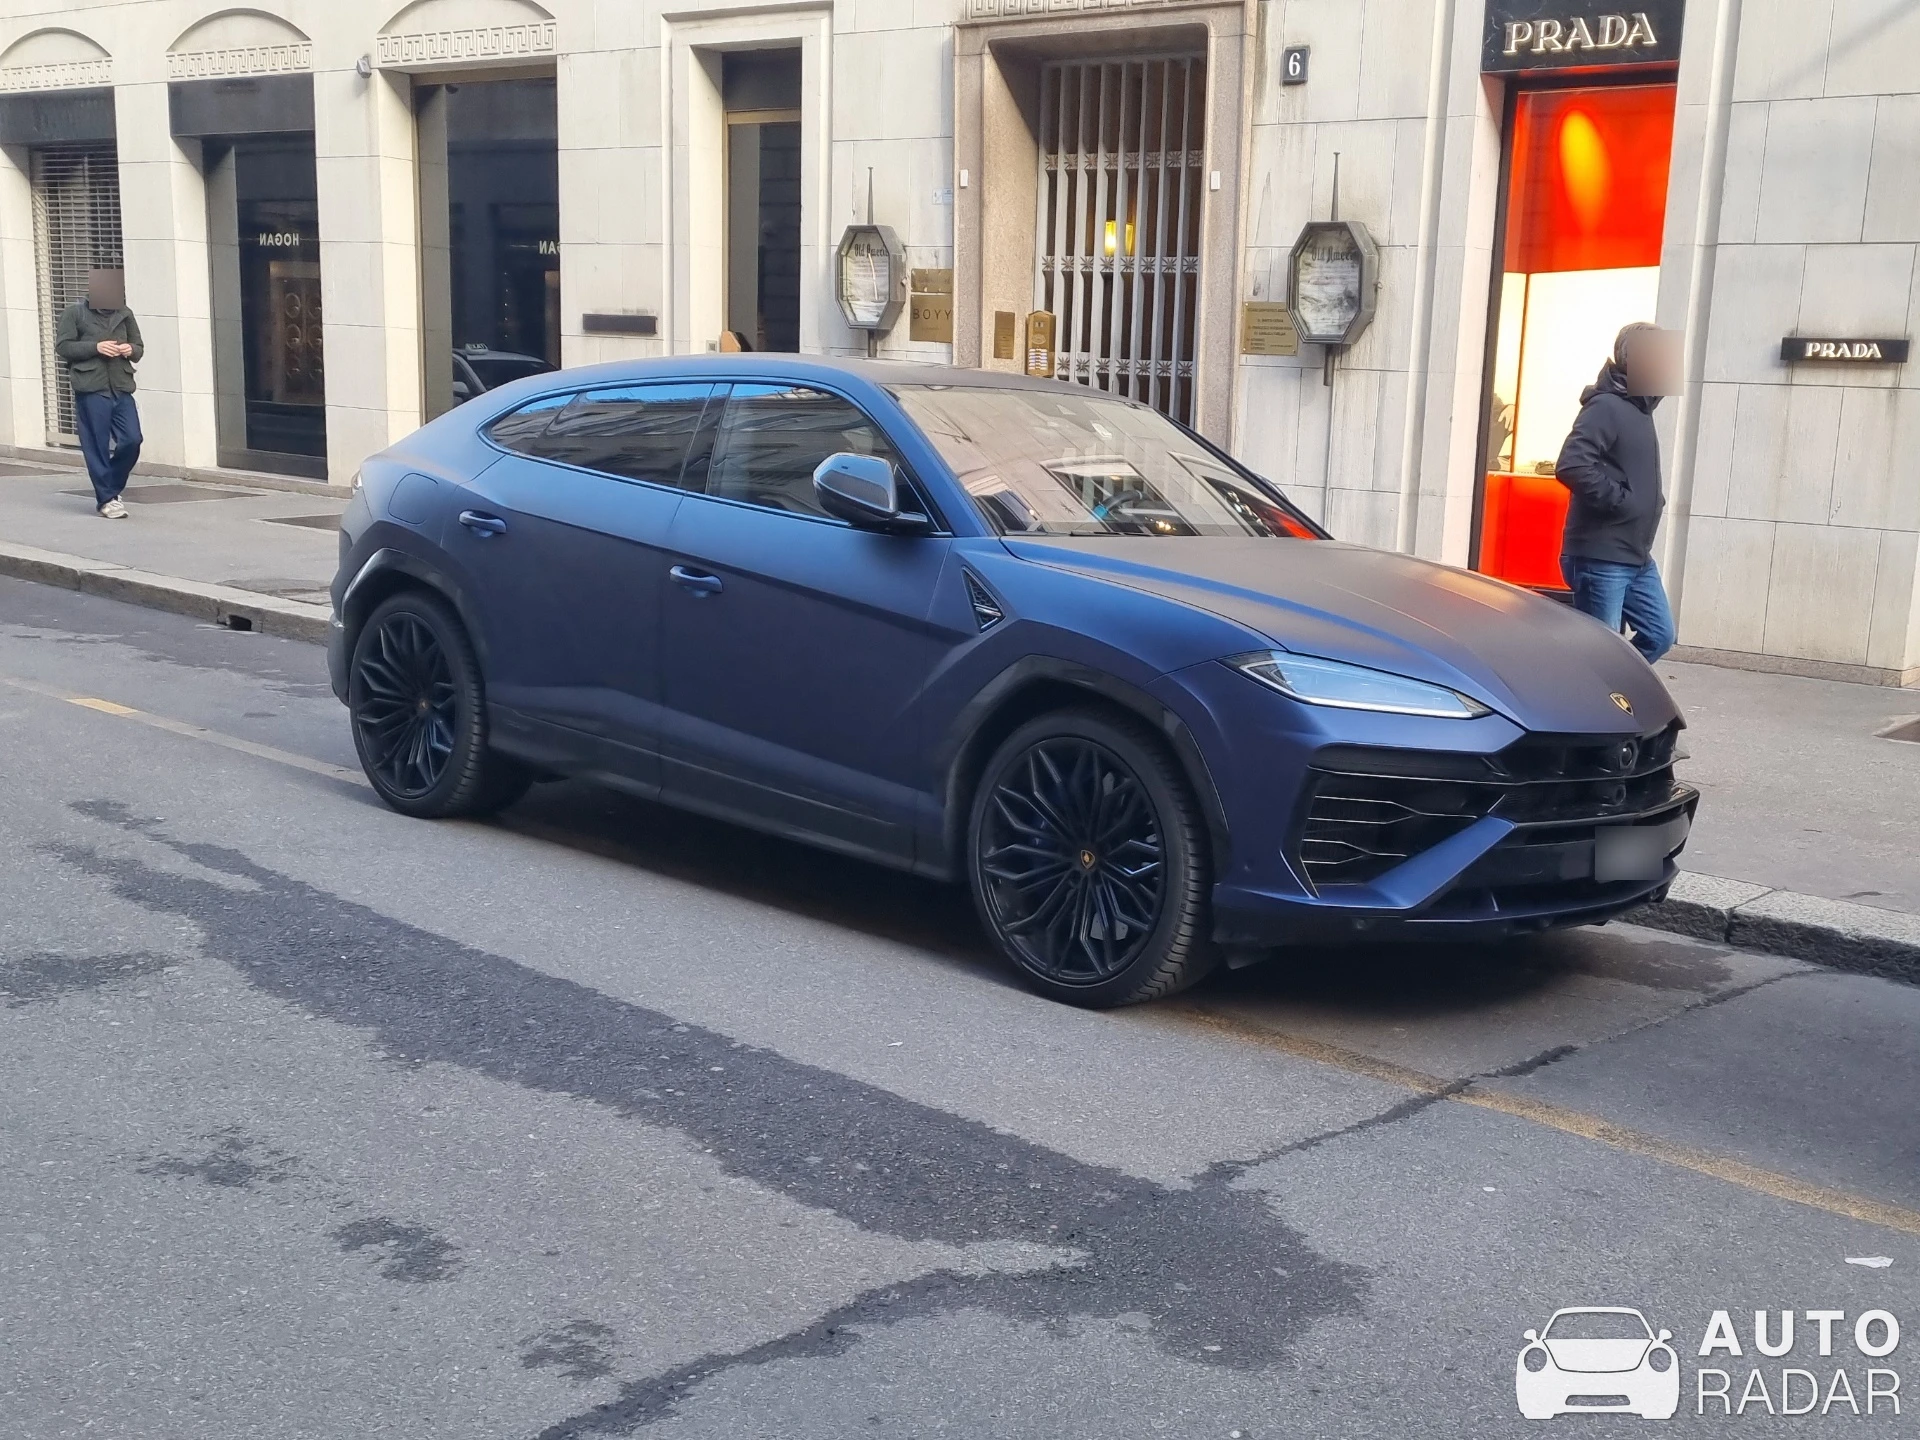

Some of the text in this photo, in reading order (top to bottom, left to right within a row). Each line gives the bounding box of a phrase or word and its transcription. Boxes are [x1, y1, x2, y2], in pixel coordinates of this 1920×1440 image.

[1502, 13, 1657, 54] PRADA
[1288, 52, 1301, 77] 6
[912, 308, 952, 320] BOYY
[1804, 342, 1882, 358] PRADA
